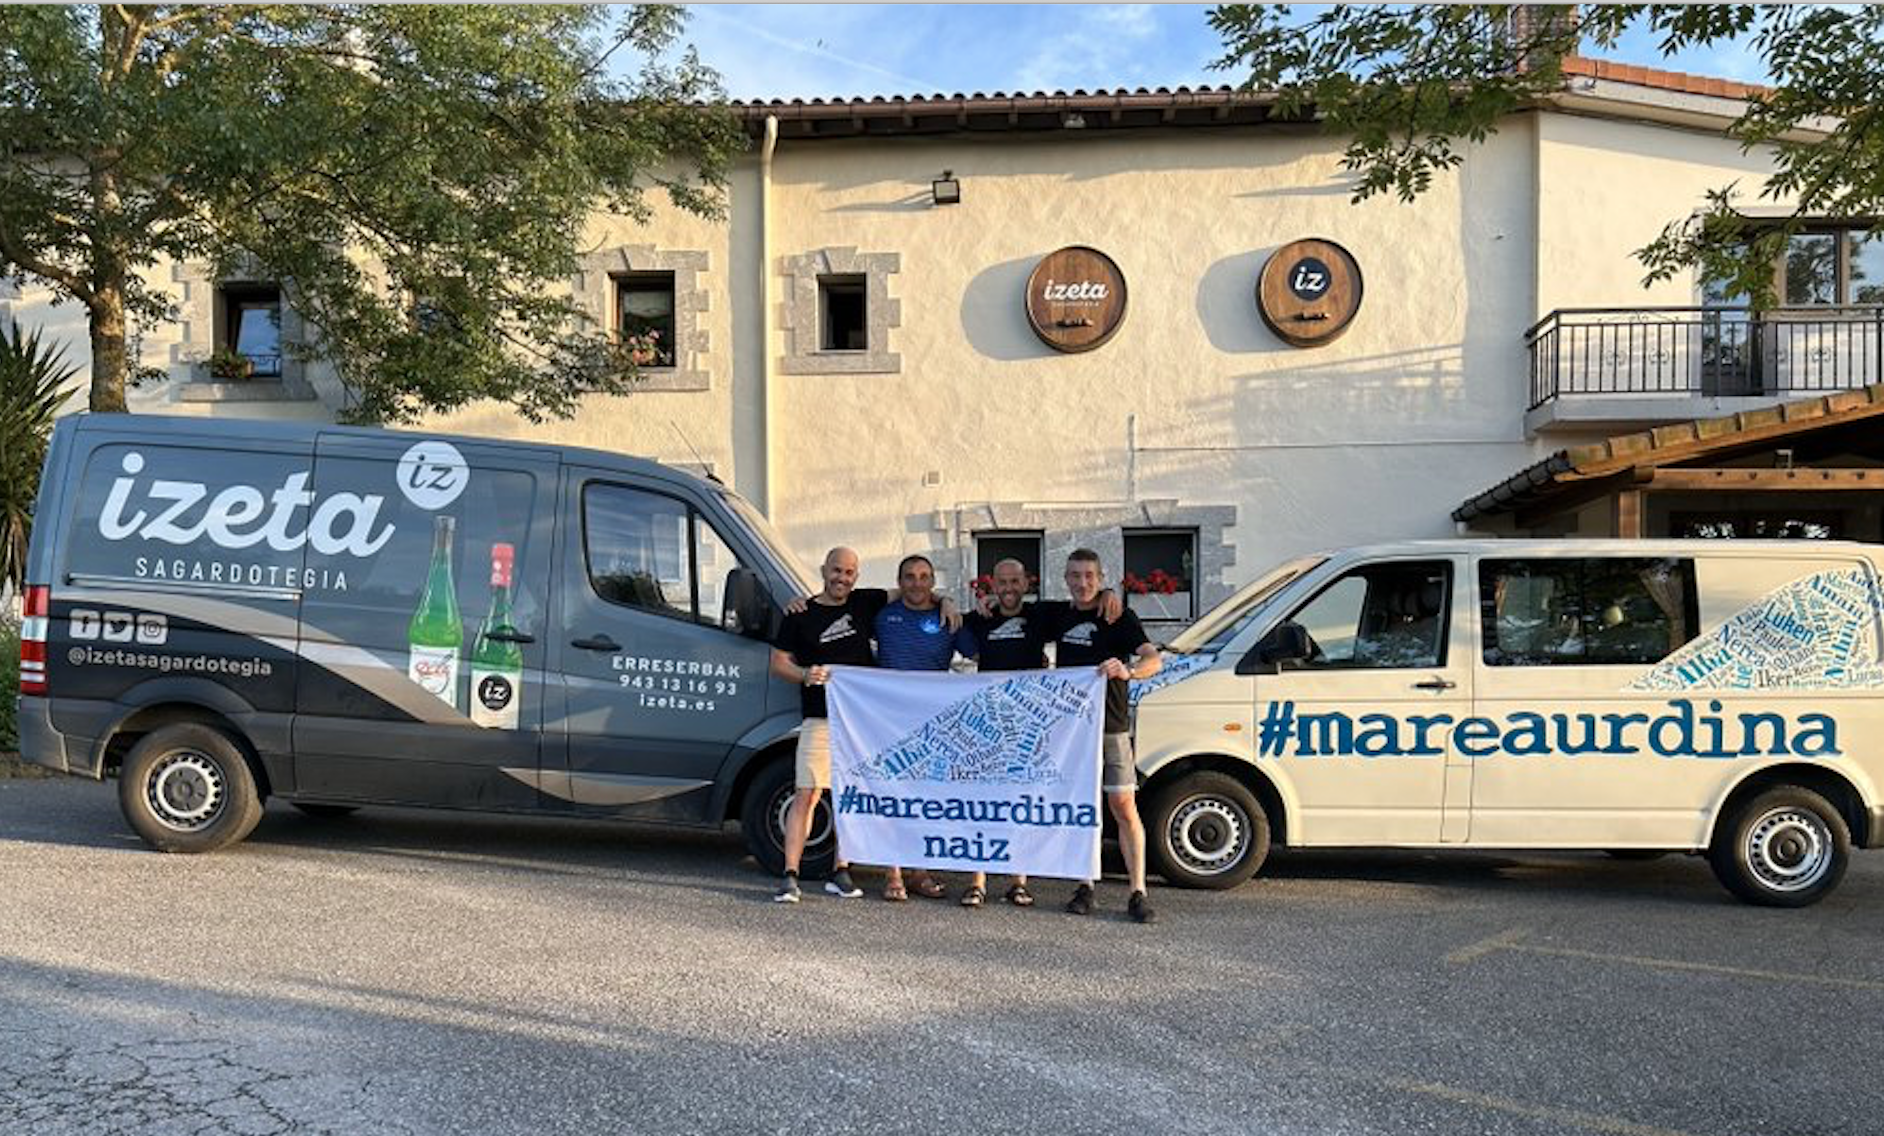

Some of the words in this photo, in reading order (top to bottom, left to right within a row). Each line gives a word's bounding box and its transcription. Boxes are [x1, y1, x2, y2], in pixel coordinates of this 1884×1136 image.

[1044, 279, 1110, 300] izeta
[1294, 266, 1325, 291] iz
[408, 454, 458, 489] iz
[99, 452, 396, 558] izeta
[135, 557, 348, 591] SAGARDOTEGIA
[1763, 602, 1816, 645] Luken
[67, 645, 272, 678] @izetasagardotegia
[1718, 624, 1767, 667] Nerea
[612, 655, 741, 679] ERRESERBAK
[1757, 669, 1793, 688] Iker
[485, 680, 509, 700] iz
[619, 674, 655, 690] 943
[661, 677, 682, 692] 13
[688, 680, 708, 694] 16
[714, 681, 737, 696] 93
[639, 693, 716, 711] izeta.es
[957, 703, 1003, 744] Luken
[1258, 700, 1845, 759] #mareaurdina
[917, 722, 958, 763] Nerea
[883, 742, 930, 777] Alba
[950, 765, 981, 782] Iker
[838, 784, 1099, 828] #mareaurdina
[923, 832, 1011, 862] naiz
